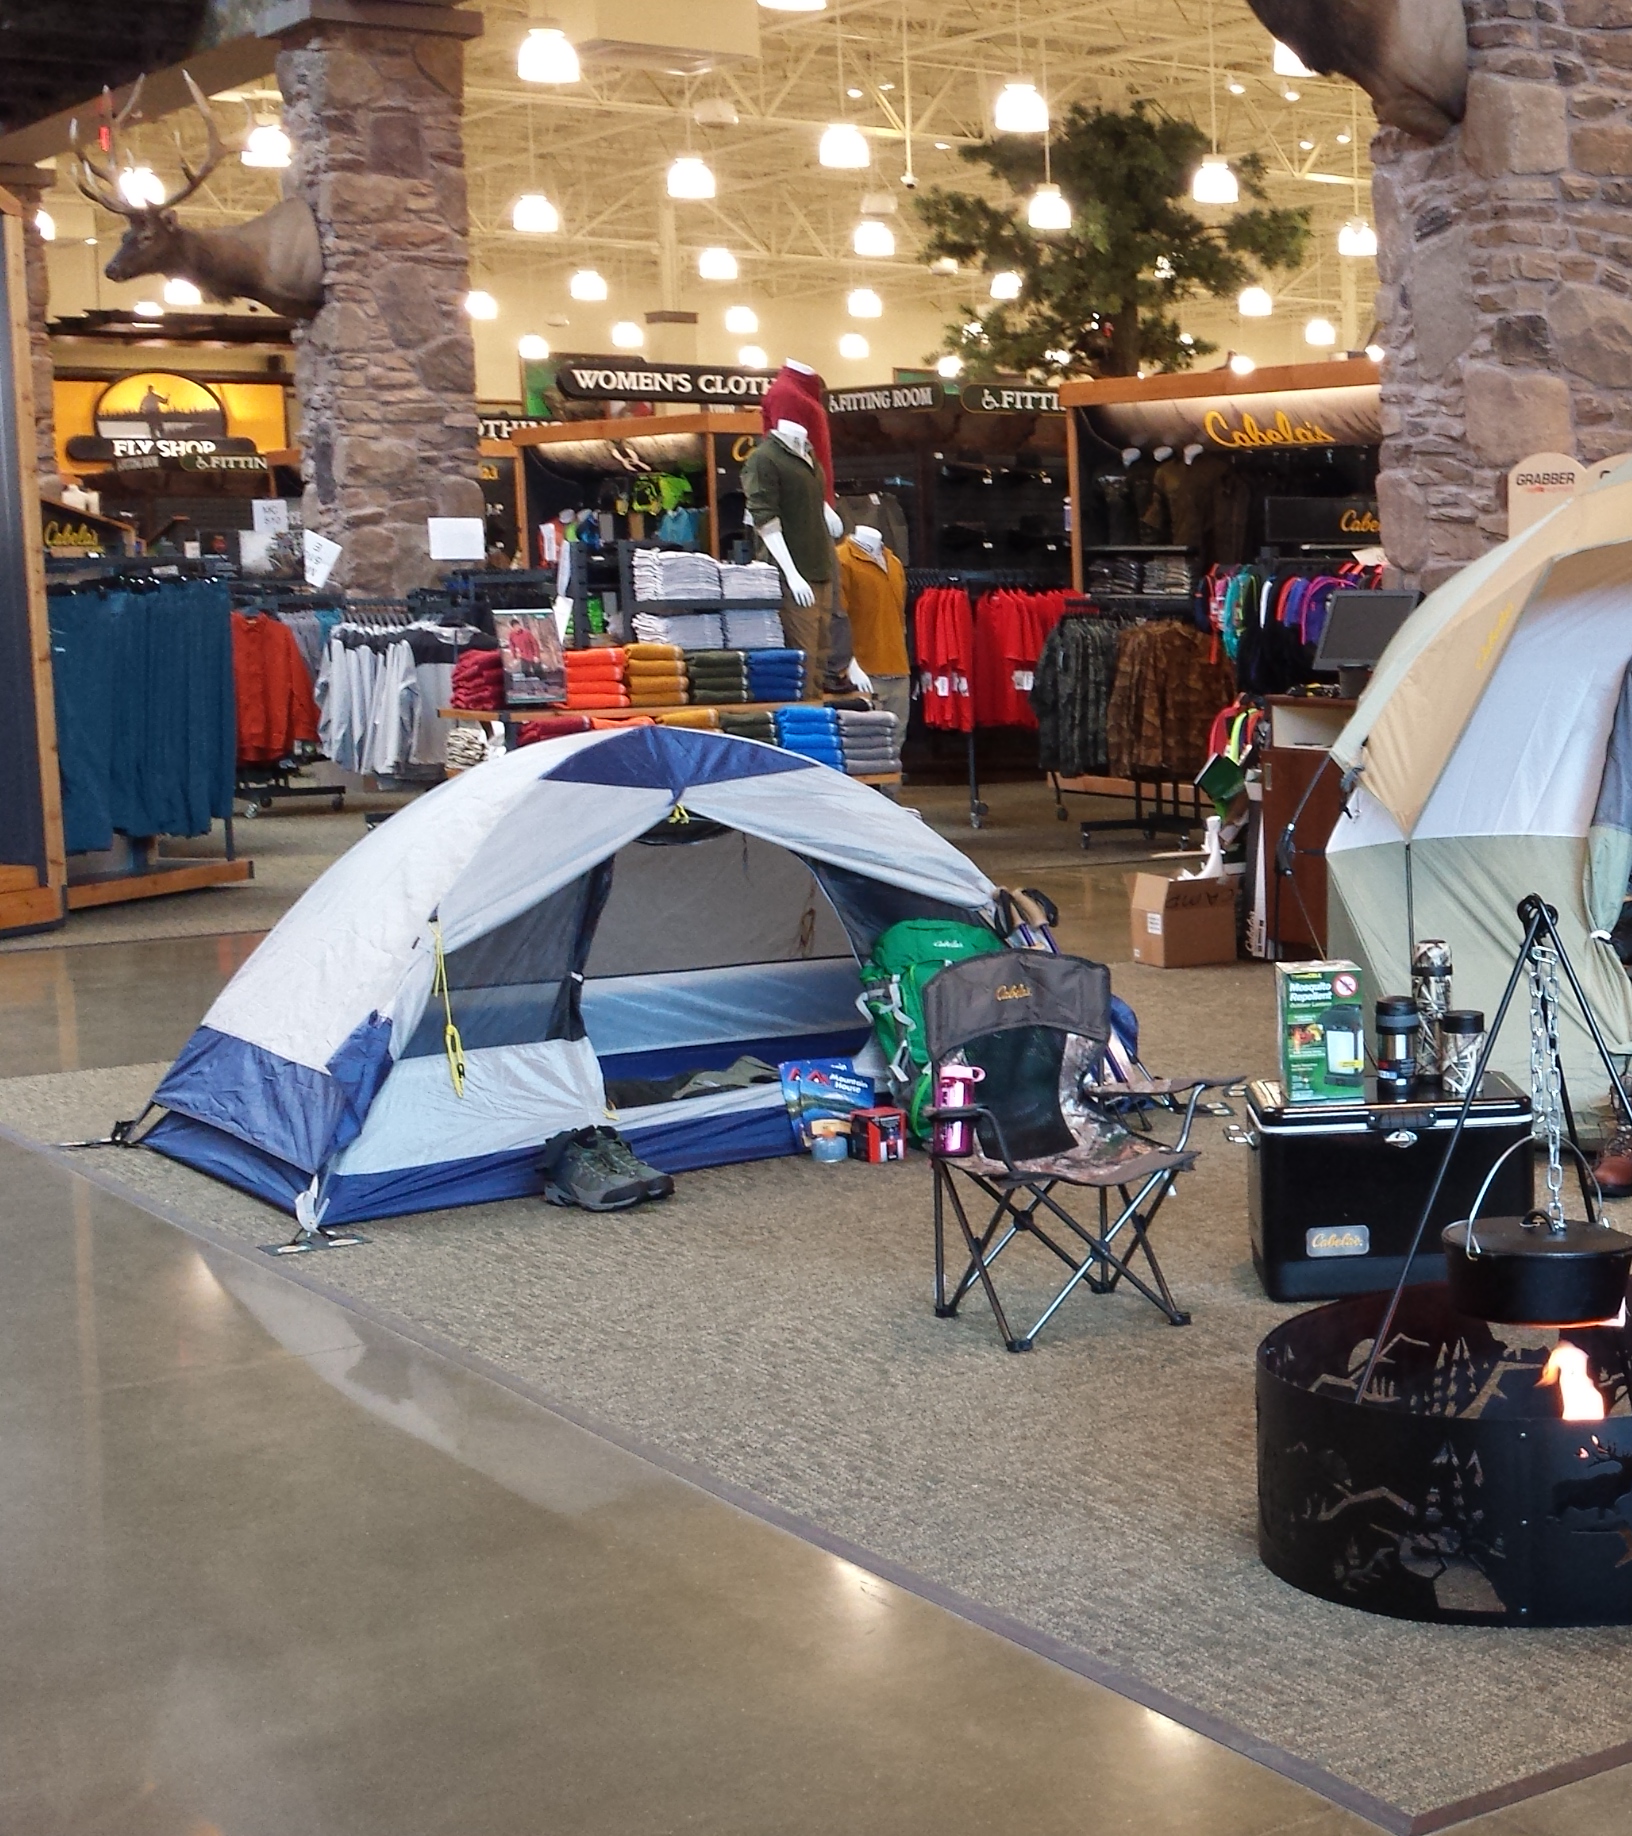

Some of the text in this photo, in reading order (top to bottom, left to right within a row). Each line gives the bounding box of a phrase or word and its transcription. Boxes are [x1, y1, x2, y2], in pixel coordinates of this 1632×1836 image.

[573, 370, 691, 393] WOMEN'S
[839, 387, 933, 412] FITTING ROOM
[1001, 390, 1066, 411] FITTI
[1204, 410, 1336, 448] Cabela's
[113, 440, 216, 457] FLY SHOP
[1516, 472, 1575, 486] GRABBER
[1290, 982, 1332, 993] Mosquito
[1290, 991, 1332, 1002] Repellent
[829, 1073, 869, 1089] Mountain
[834, 1081, 862, 1094] House
[1312, 1233, 1361, 1248] Cabela's
